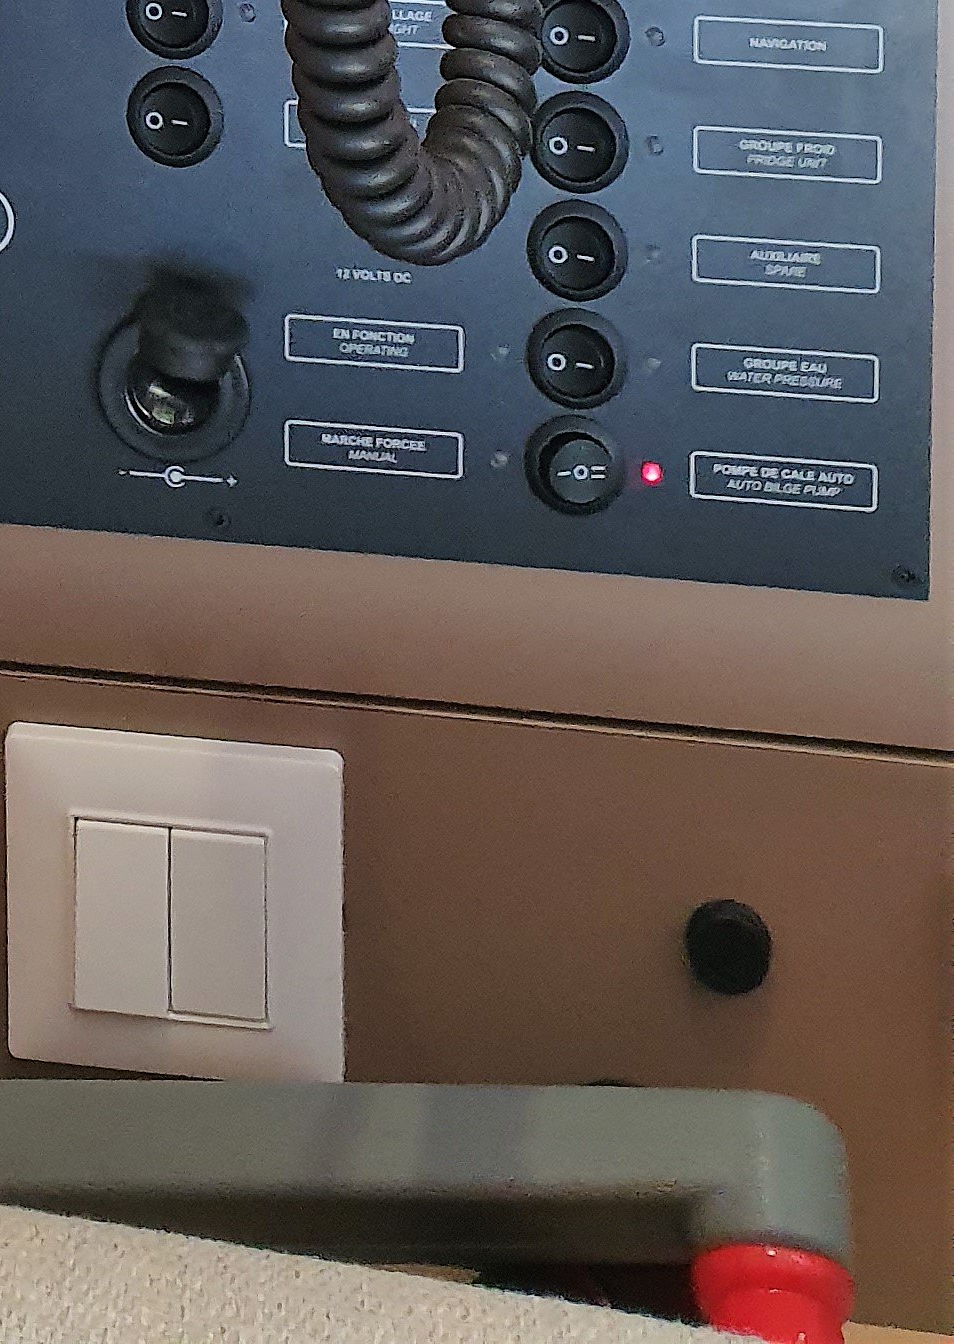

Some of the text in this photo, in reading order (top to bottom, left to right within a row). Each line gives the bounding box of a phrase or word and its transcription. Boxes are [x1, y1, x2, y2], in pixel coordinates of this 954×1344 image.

[749, 37, 827, 52] NAVIGATION
[353, 269, 391, 282] VOLTS
[339, 343, 409, 357] OPERATING
